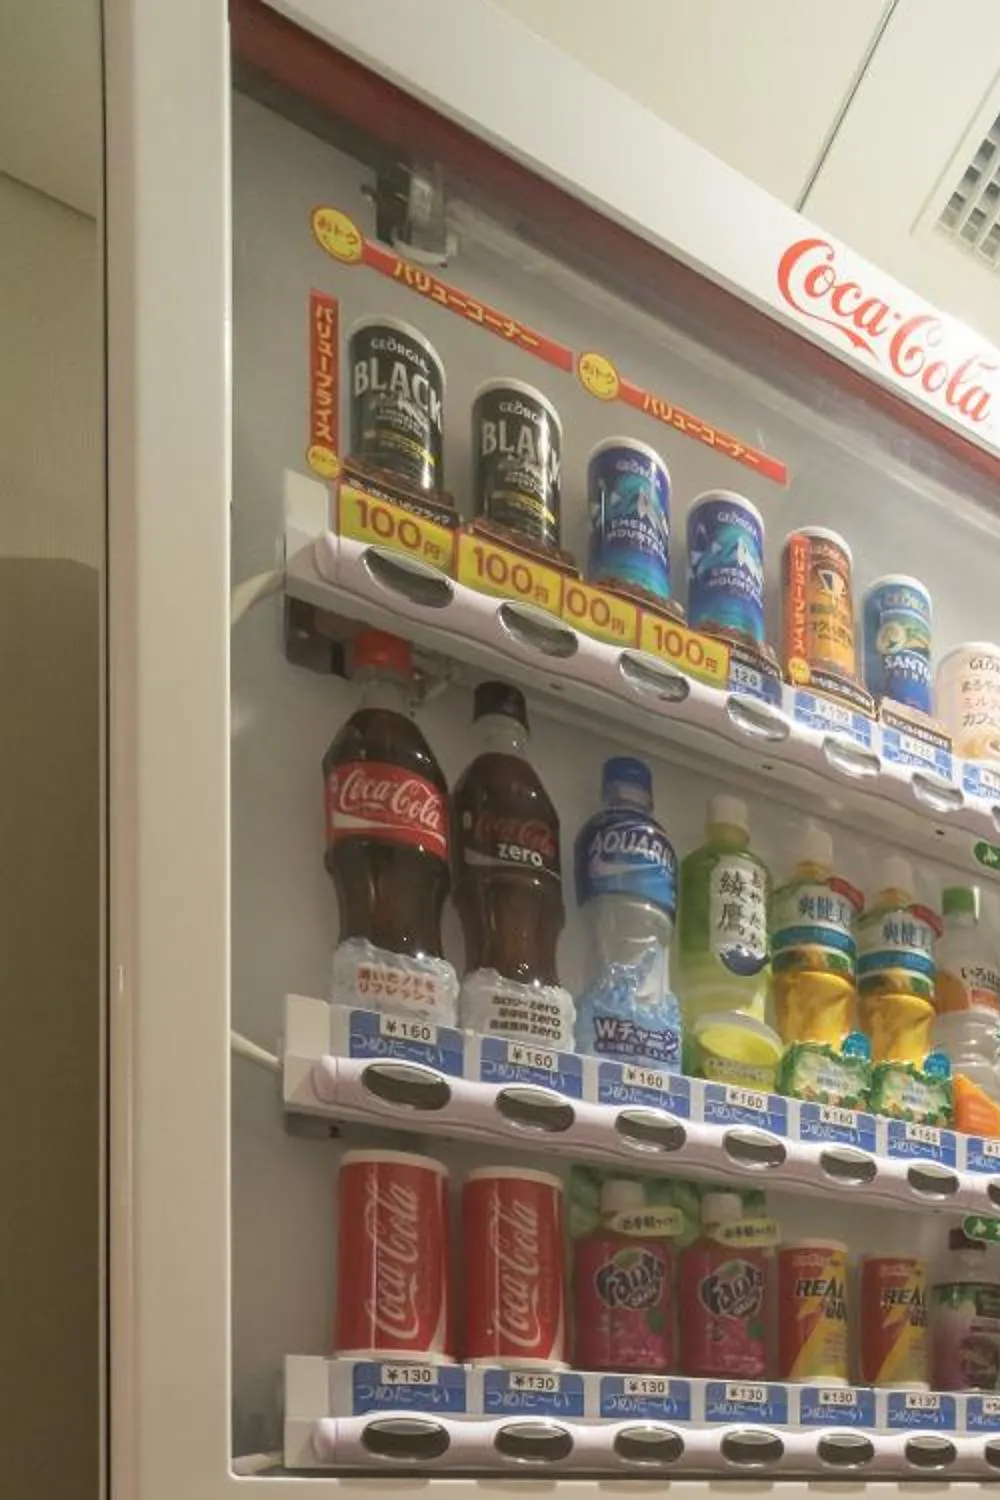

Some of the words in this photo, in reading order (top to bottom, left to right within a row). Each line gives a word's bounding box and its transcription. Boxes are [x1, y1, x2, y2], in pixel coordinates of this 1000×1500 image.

[393, 259, 540, 349] バリューコーナー
[777, 238, 999, 423] Coca-Cola
[354, 356, 443, 432] BLACK
[642, 391, 762, 467] バリューコーナー
[355, 498, 441, 561] 100円
[473, 545, 550, 605] 100円
[567, 589, 625, 635] 00円
[653, 625, 718, 673] 100円
[340, 767, 444, 832] Coca-Cola
[496, 842, 544, 867] zero
[588, 830, 675, 875] AQUARIU
[529, 999, 561, 1015] zero
[530, 1010, 561, 1028] zero
[385, 1019, 432, 1041] ¥160
[530, 1022, 561, 1041] zero
[511, 1048, 554, 1070] ¥160
[626, 1068, 664, 1088] ¥160
[364, 1169, 420, 1340] Coca-Cola
[488, 1188, 542, 1348] Coca-Cola
[386, 1368, 432, 1383] ¥130
[514, 1374, 555, 1391] ¥130
[628, 1381, 665, 1394] ¥130
